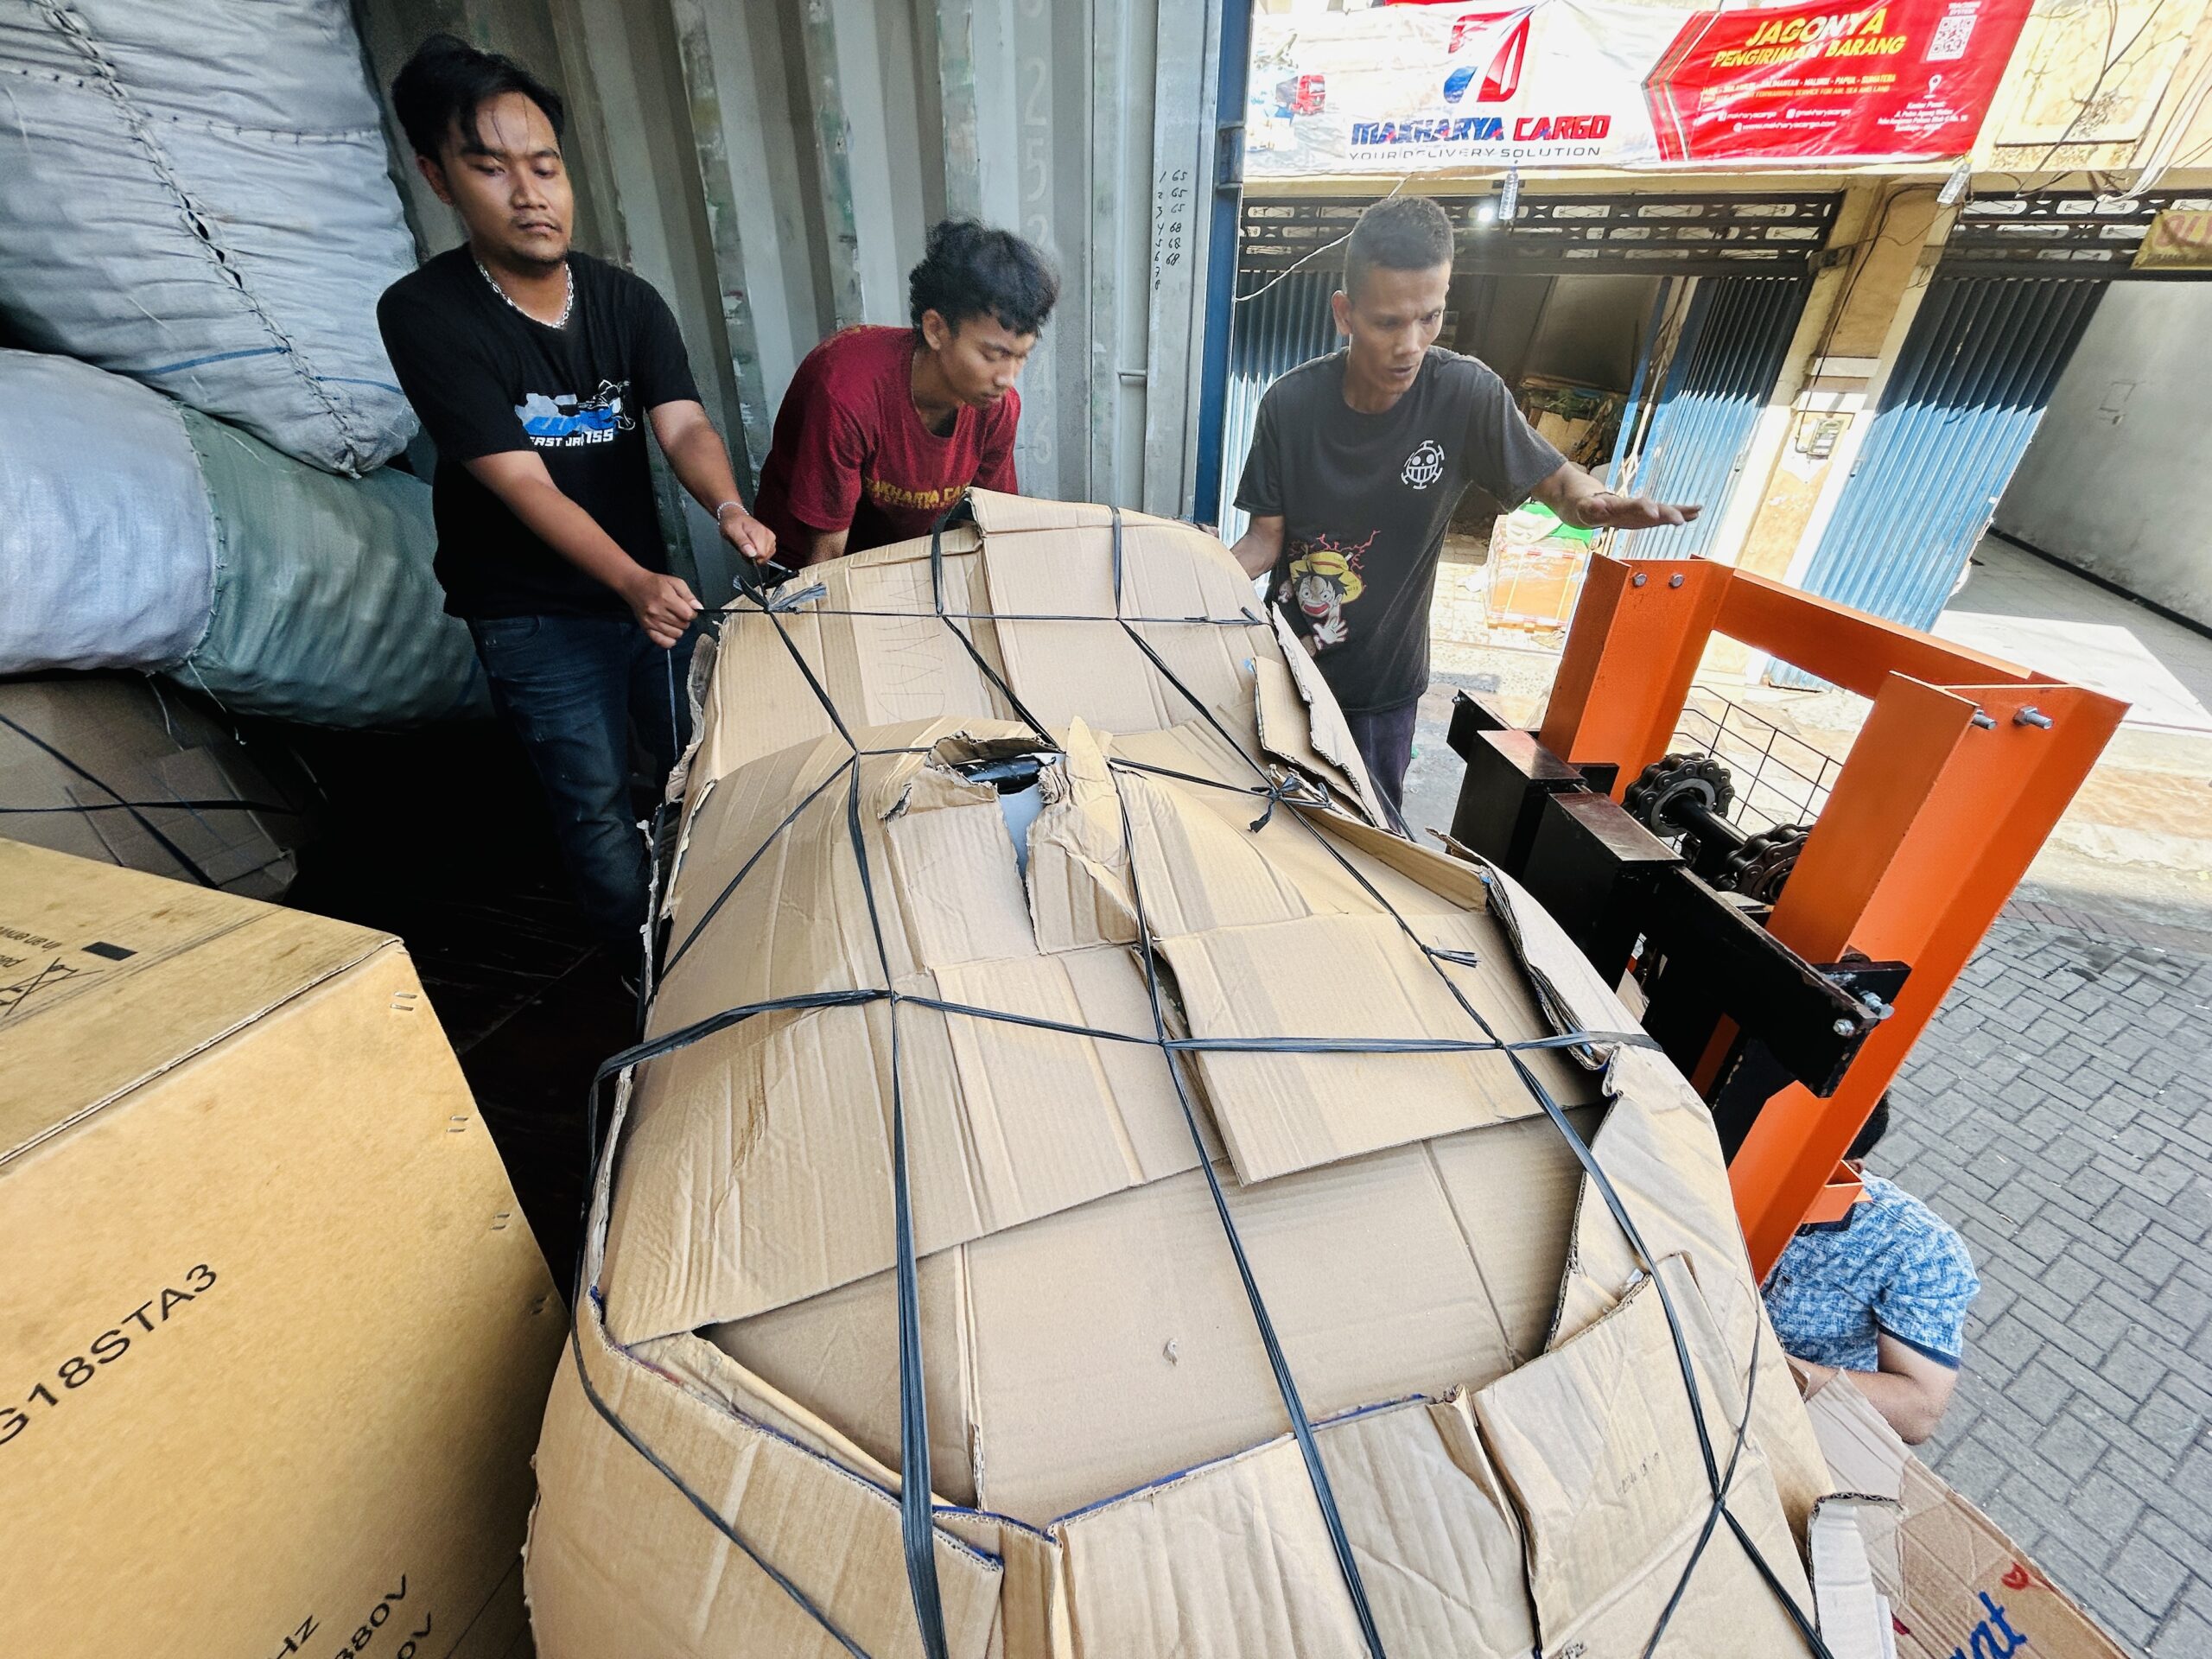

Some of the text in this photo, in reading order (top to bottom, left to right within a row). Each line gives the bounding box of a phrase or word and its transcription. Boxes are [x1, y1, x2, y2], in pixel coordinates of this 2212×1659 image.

[1745, 8, 1887, 47] JAGONYA
[1711, 35, 1907, 68] PENGIRIMAN BARANG
[1513, 115, 1611, 141] CARGO
[1350, 147, 1601, 161] YOUR DELIVERY SOLUTION
[1170, 222, 1182, 232] 68
[0, 1263, 218, 1446] G18STA3
